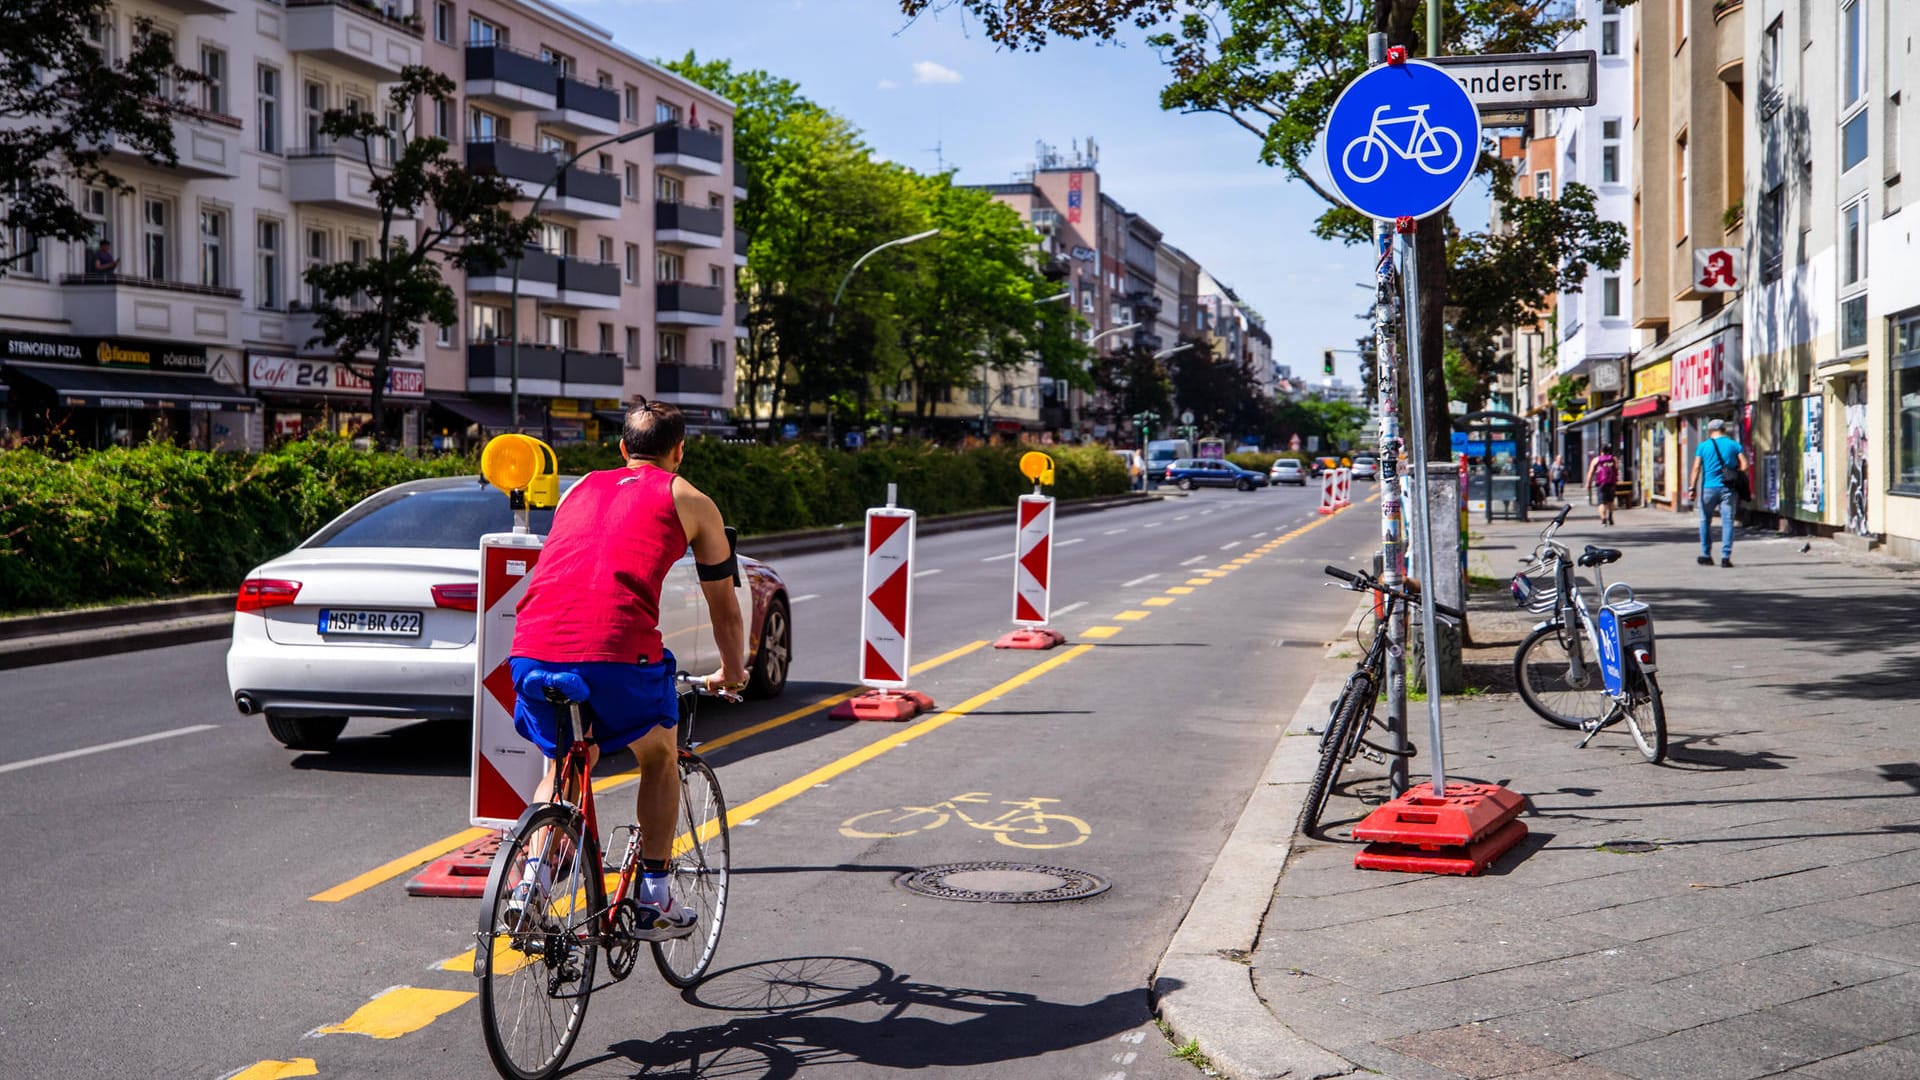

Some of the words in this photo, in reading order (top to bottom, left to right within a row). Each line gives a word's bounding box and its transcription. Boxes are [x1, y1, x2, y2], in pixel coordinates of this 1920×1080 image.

[8, 340, 55, 356] STEINOFEN
[58, 345, 81, 359] PIZZA
[296, 363, 329, 387] 24
[394, 372, 422, 393] SHOP
[1674, 342, 1724, 401] APOTHEKE
[329, 613, 357, 630] MSP
[368, 614, 387, 631] BR
[391, 615, 418, 632] 622
